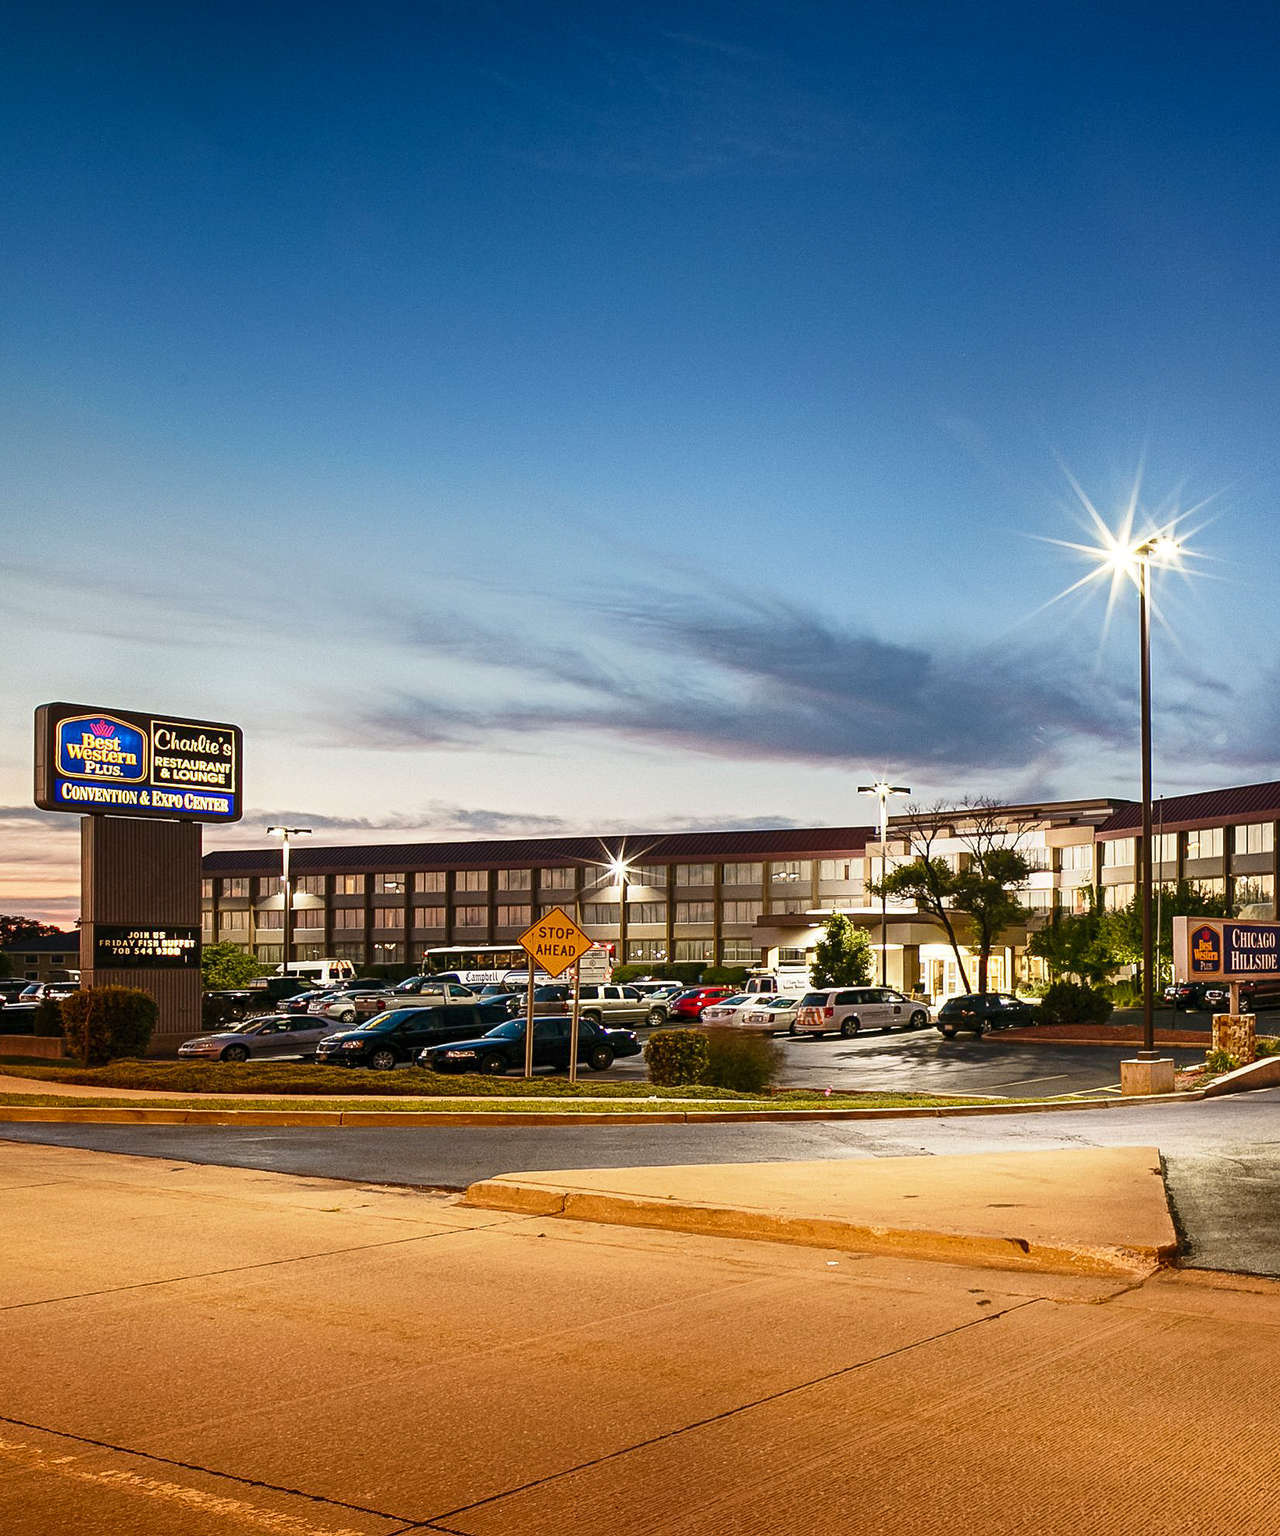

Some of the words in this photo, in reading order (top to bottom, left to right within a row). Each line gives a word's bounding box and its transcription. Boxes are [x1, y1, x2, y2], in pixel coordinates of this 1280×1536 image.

[81, 732, 121, 751] Best
[154, 729, 232, 756] Charlie's
[66, 743, 137, 765] Western
[155, 756, 231, 774] RESTAURANT
[160, 768, 170, 779] &
[173, 771, 226, 785] LOUNGE
[61, 782, 138, 804] CONVENTION
[139, 790, 150, 806] &
[152, 790, 183, 809] EXPO
[184, 793, 229, 812] CENTER
[127, 931, 150, 939] JOIN
[152, 931, 166, 939] US
[538, 926, 575, 939] STOP
[1232, 928, 1276, 948] CHICAGO
[99, 939, 136, 947] FRIDAY
[138, 939, 159, 947] FISH
[112, 947, 130, 955] 708
[134, 947, 153, 955] 544
[535, 944, 576, 957] AHEAD
[1231, 951, 1278, 970] HILLSIDE
[465, 971, 499, 983] Campbell
